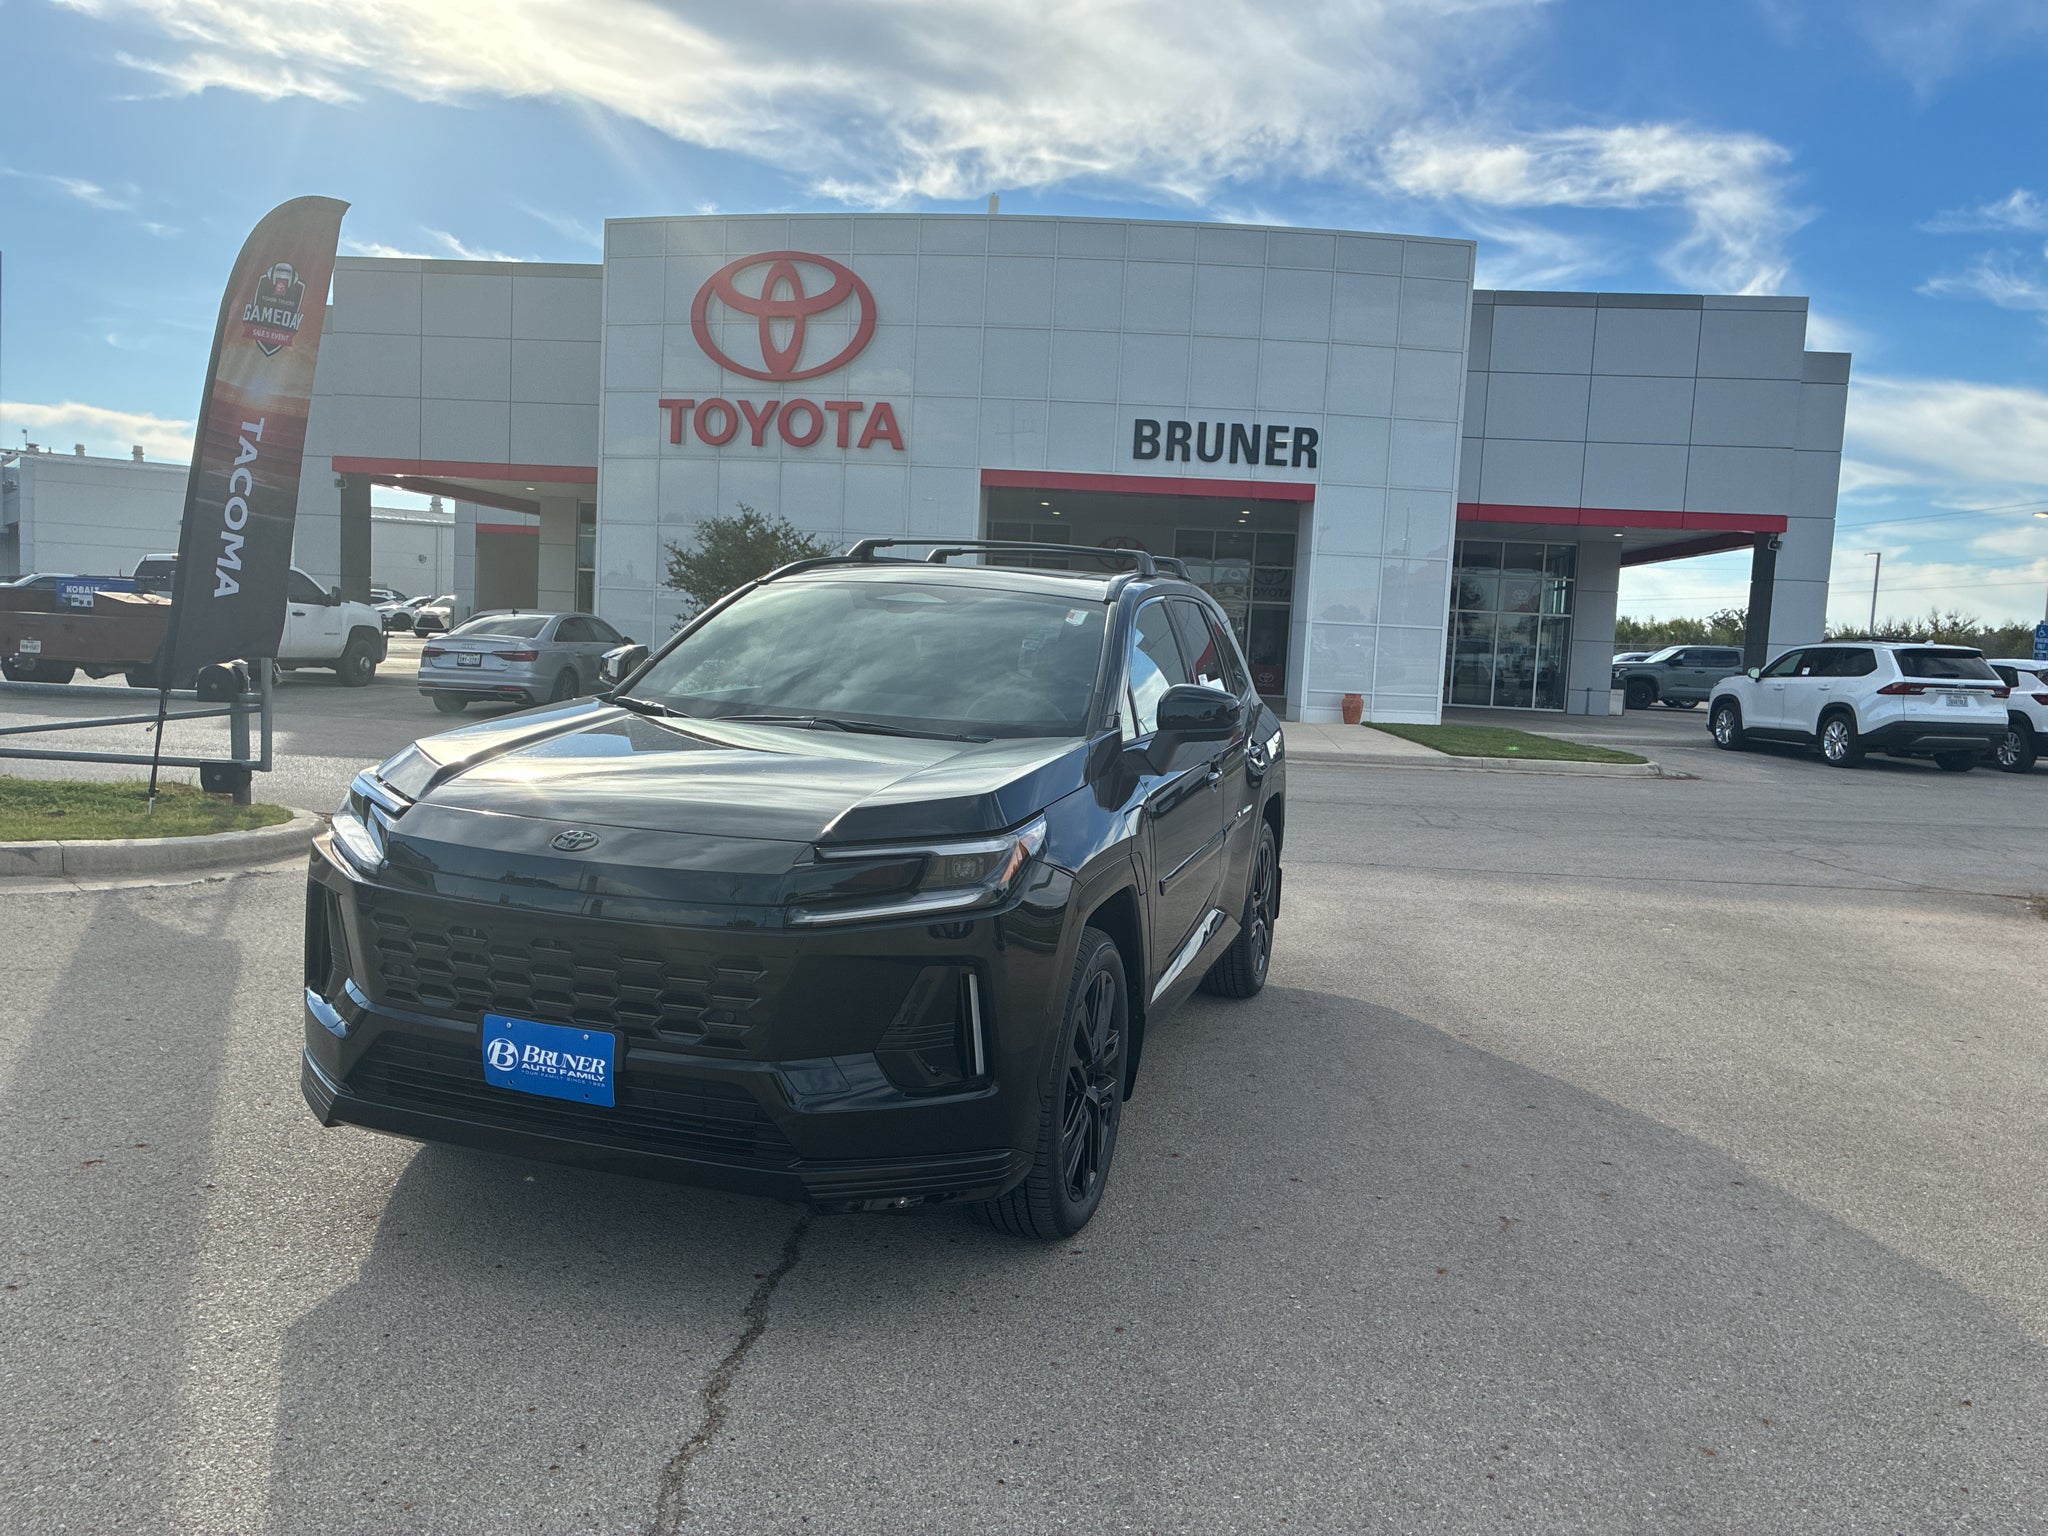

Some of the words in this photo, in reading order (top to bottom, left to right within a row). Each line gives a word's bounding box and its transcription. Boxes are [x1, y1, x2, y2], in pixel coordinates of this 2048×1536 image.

[242, 303, 304, 331] GAMEDAY
[252, 328, 270, 338] SALES
[271, 332, 289, 342] EVENT
[658, 397, 905, 451] TOYOTA
[1133, 418, 1319, 469] BRUNER
[214, 417, 265, 598] TACOMA
[521, 1044, 606, 1075] BRUNER
[521, 1062, 557, 1074] AUTO
[559, 1068, 605, 1082] FAMILY
[540, 1072, 564, 1081] FAMILY
[566, 1077, 586, 1085] SINCE
